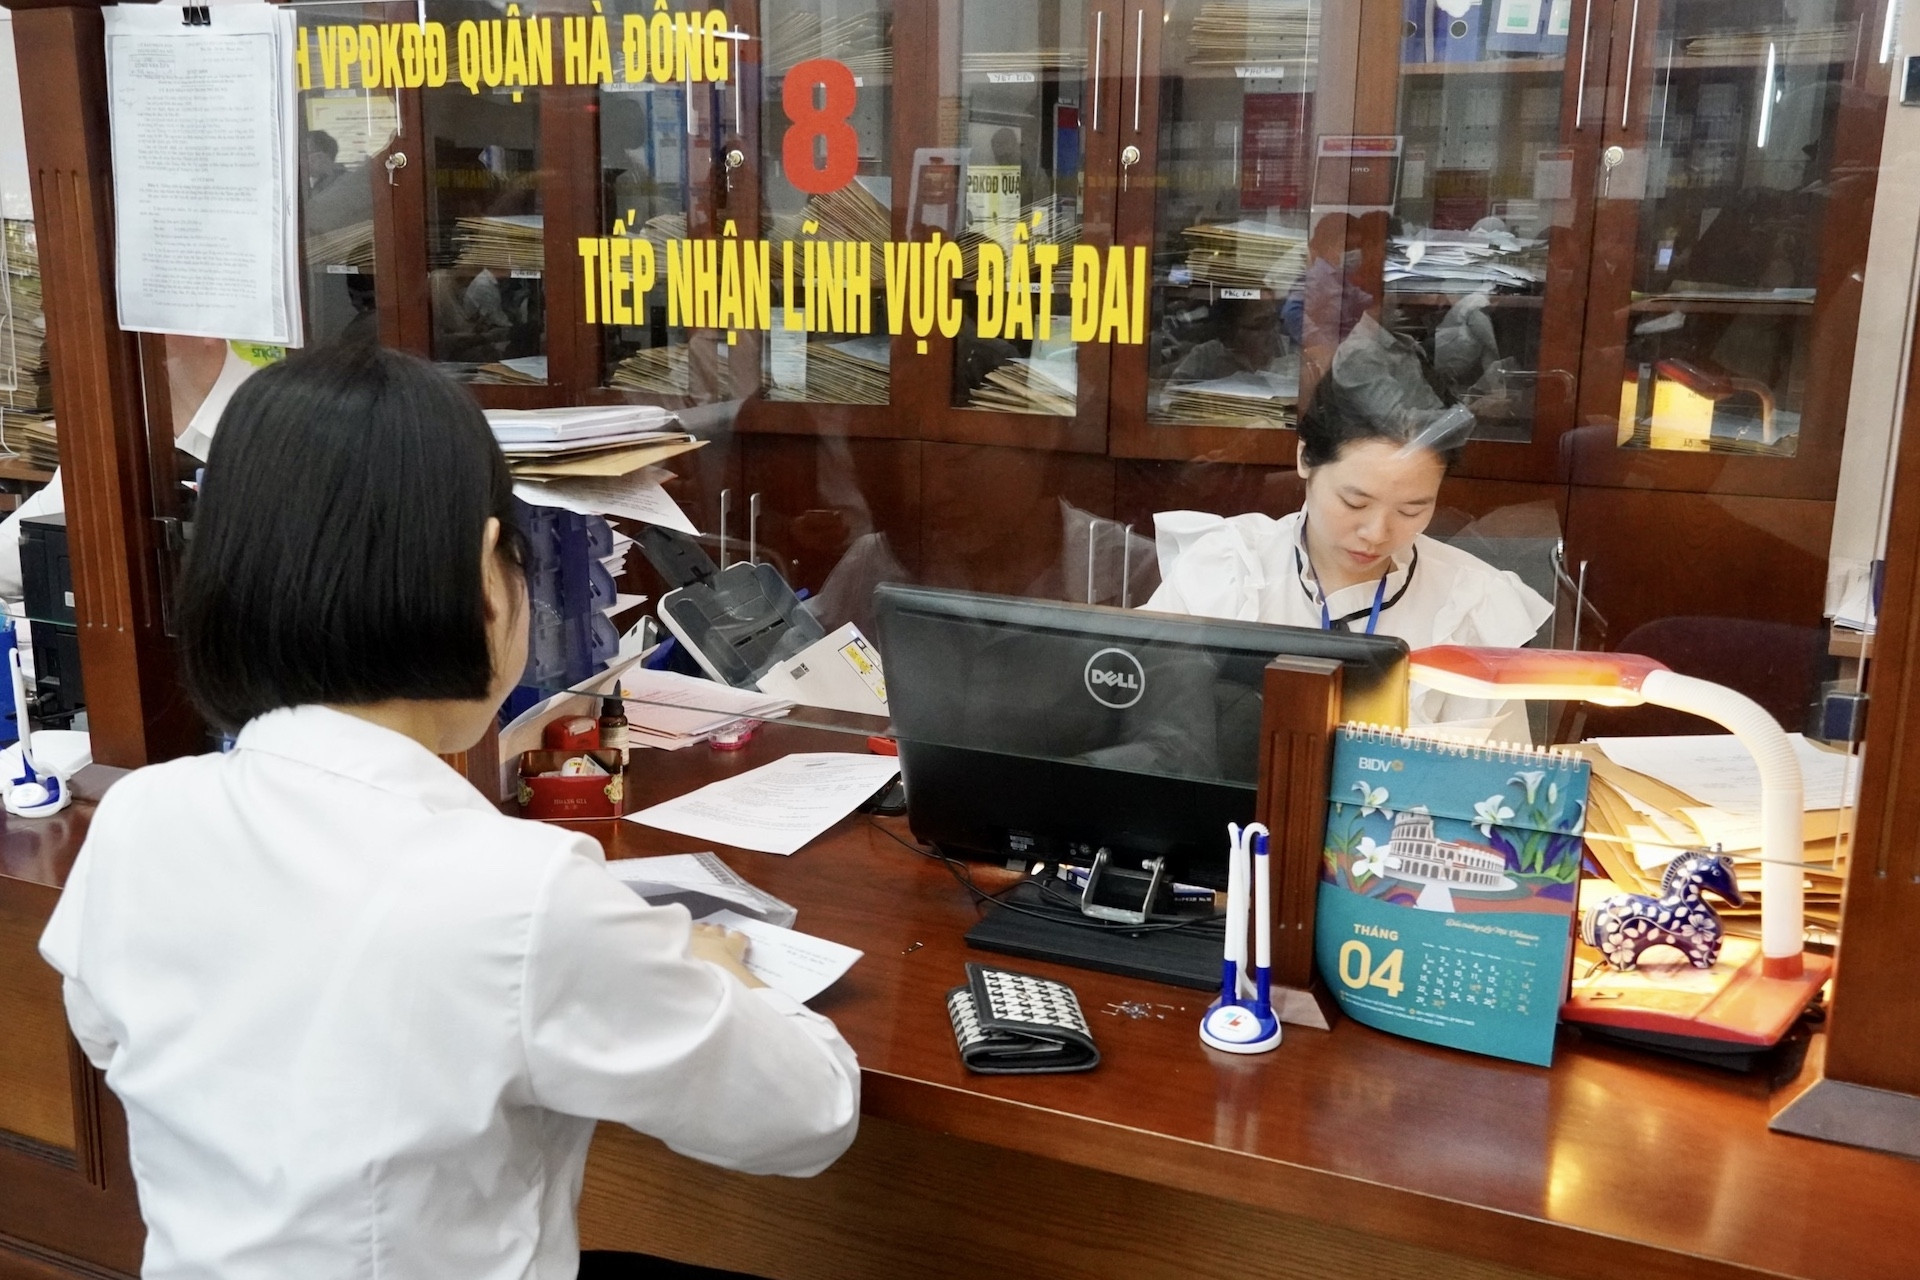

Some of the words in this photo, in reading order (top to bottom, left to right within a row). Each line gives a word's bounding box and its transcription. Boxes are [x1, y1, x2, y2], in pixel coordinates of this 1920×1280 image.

[317, 22, 448, 89] VPĐKĐĐ
[458, 3, 553, 103] QUẬN
[563, 1, 613, 85] HÀ
[623, 0, 728, 83] ĐÔNG
[782, 58, 858, 194] 8
[578, 209, 655, 325] TIẾP
[667, 219, 771, 345] NHẬN
[783, 220, 871, 334] LĨNH
[884, 232, 964, 354] VỰC
[976, 211, 1059, 341] ĐẤT
[1070, 244, 1146, 345] ĐAI
[1091, 668, 1139, 690] DELL
[1359, 756, 1392, 773] BIDV
[1353, 923, 1399, 941] THÁNG
[1338, 939, 1405, 999] 04
